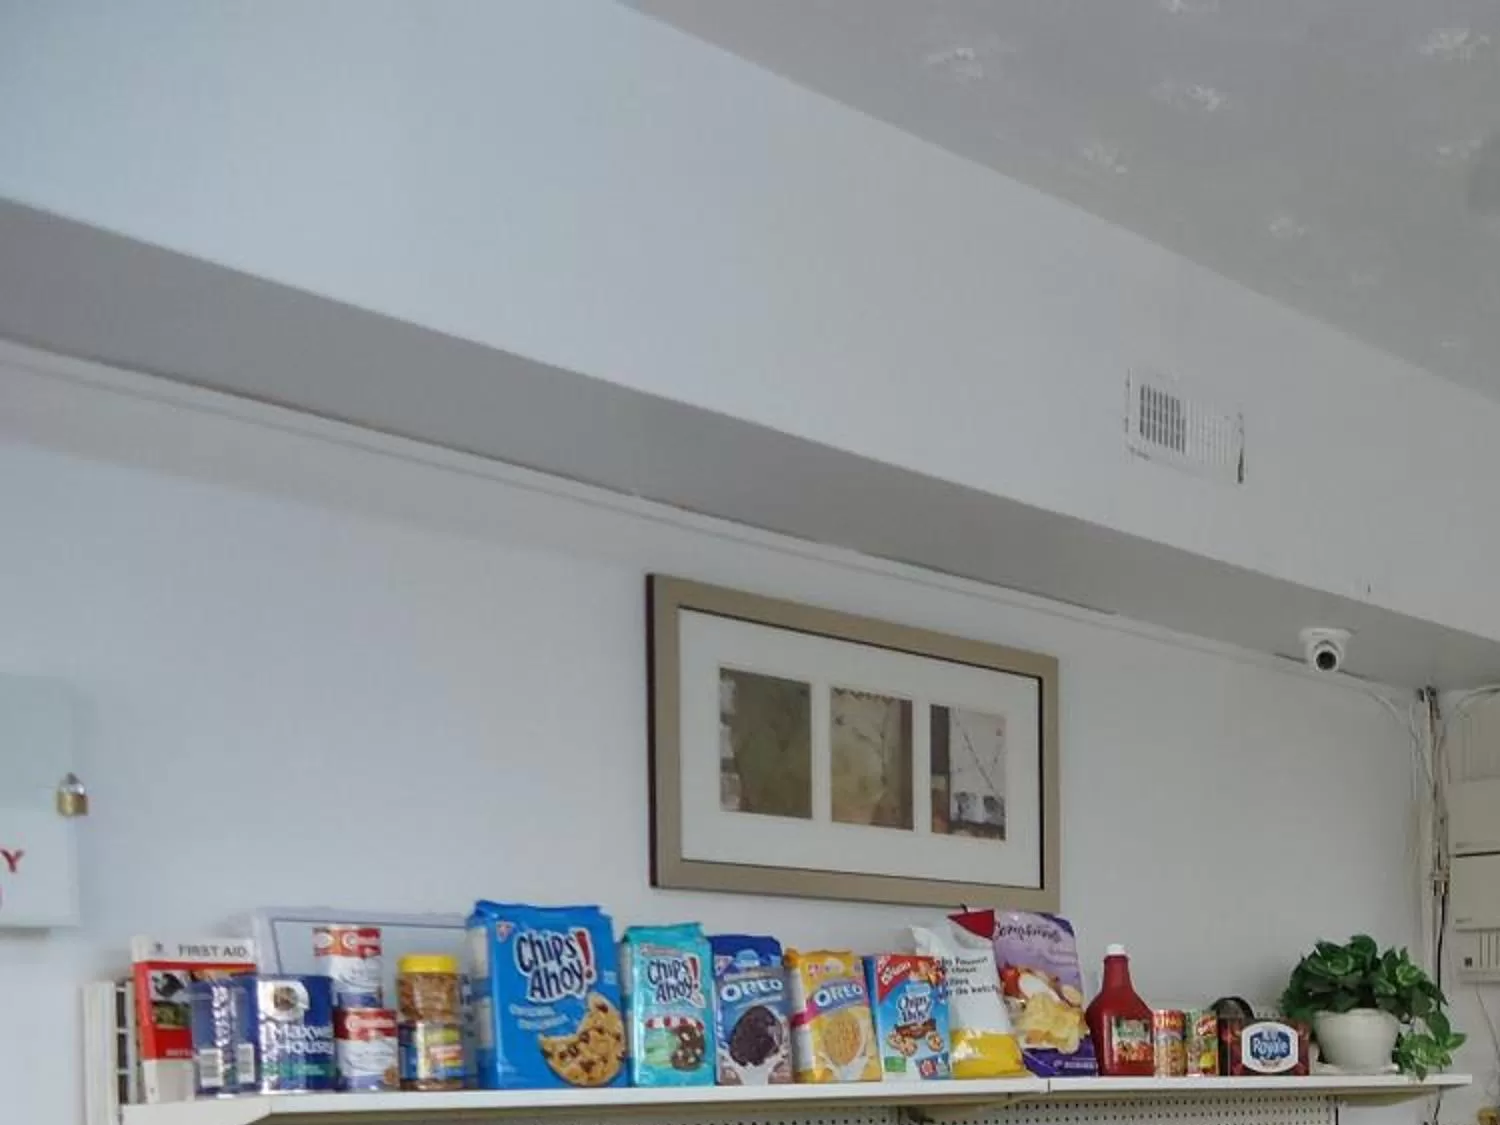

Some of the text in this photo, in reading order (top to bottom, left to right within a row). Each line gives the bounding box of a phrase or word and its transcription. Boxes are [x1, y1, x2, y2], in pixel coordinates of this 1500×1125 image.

[178, 944, 247, 957] FIRST AID
[518, 932, 577, 973] Chips
[721, 979, 784, 1001] OREO
